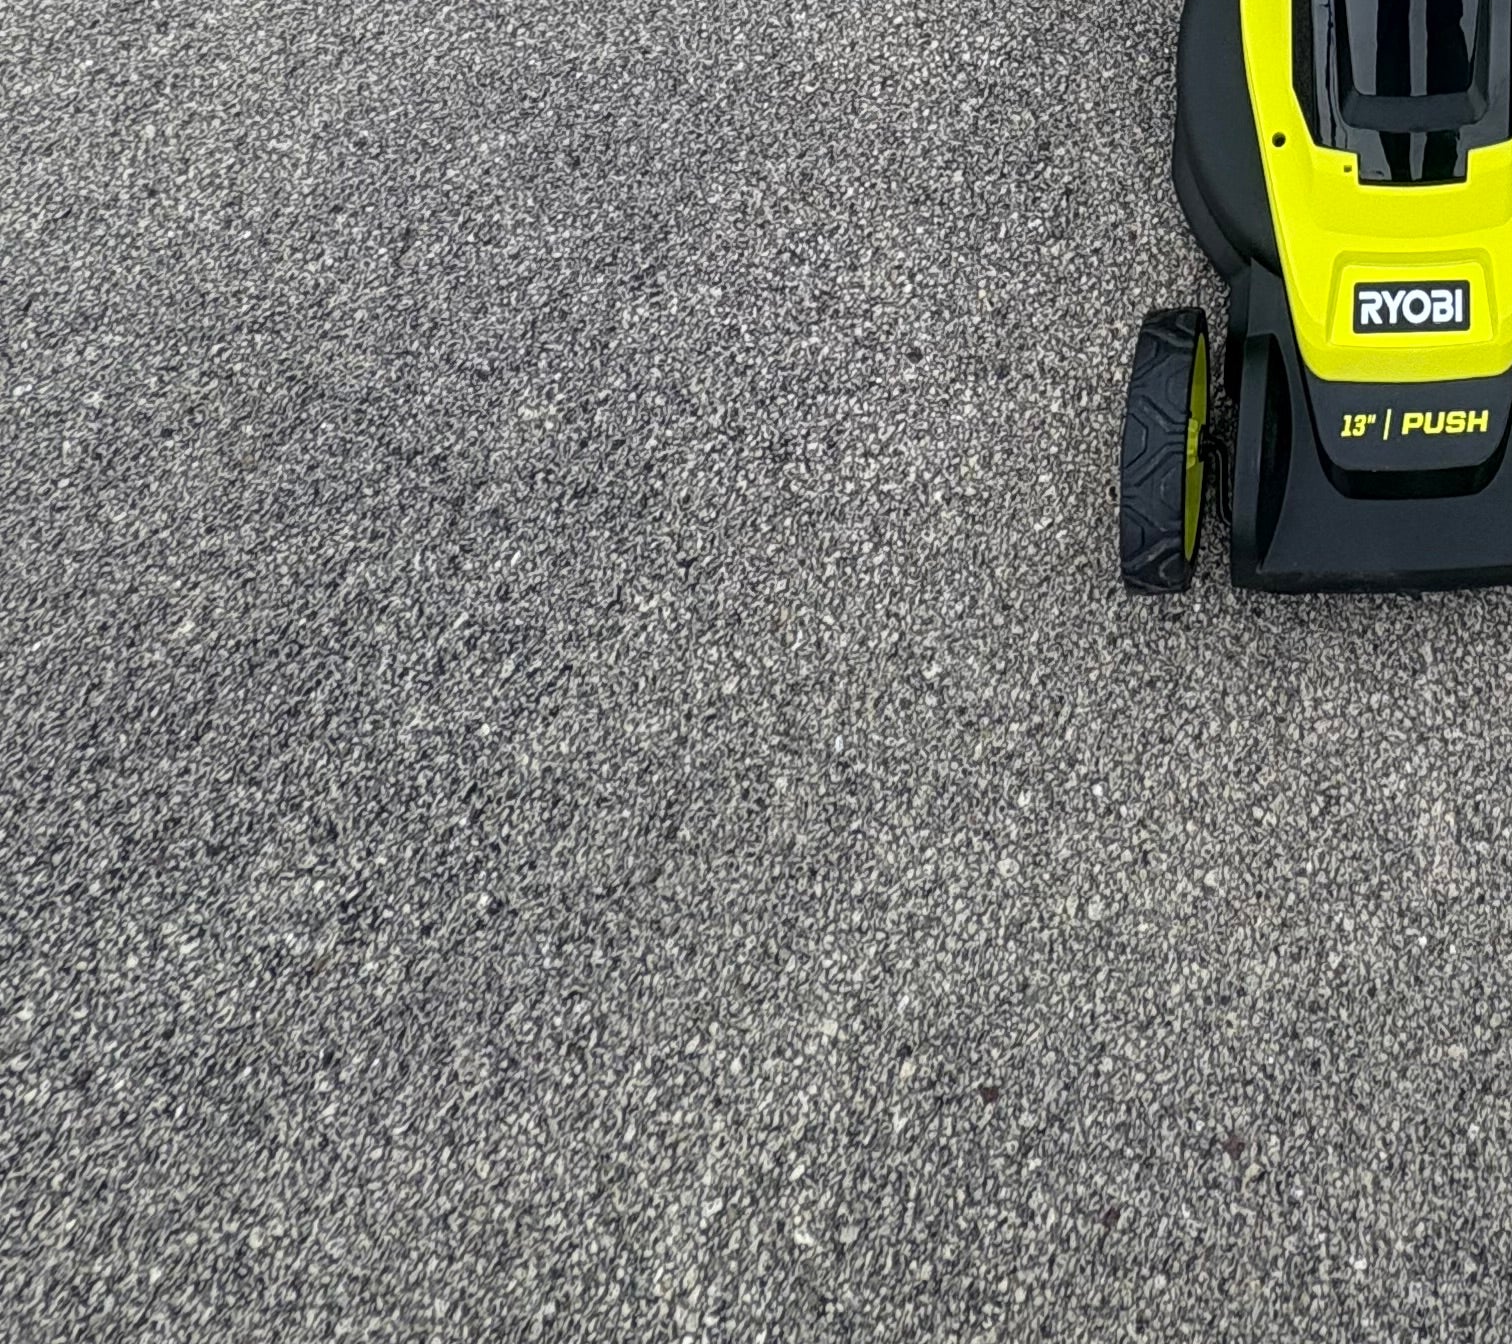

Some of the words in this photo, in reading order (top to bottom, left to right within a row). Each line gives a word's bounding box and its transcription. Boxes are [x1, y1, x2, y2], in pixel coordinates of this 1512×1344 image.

[1359, 289, 1463, 325] RYOBI
[1341, 413, 1377, 438] 13"
[1402, 410, 1489, 435] PUSH
